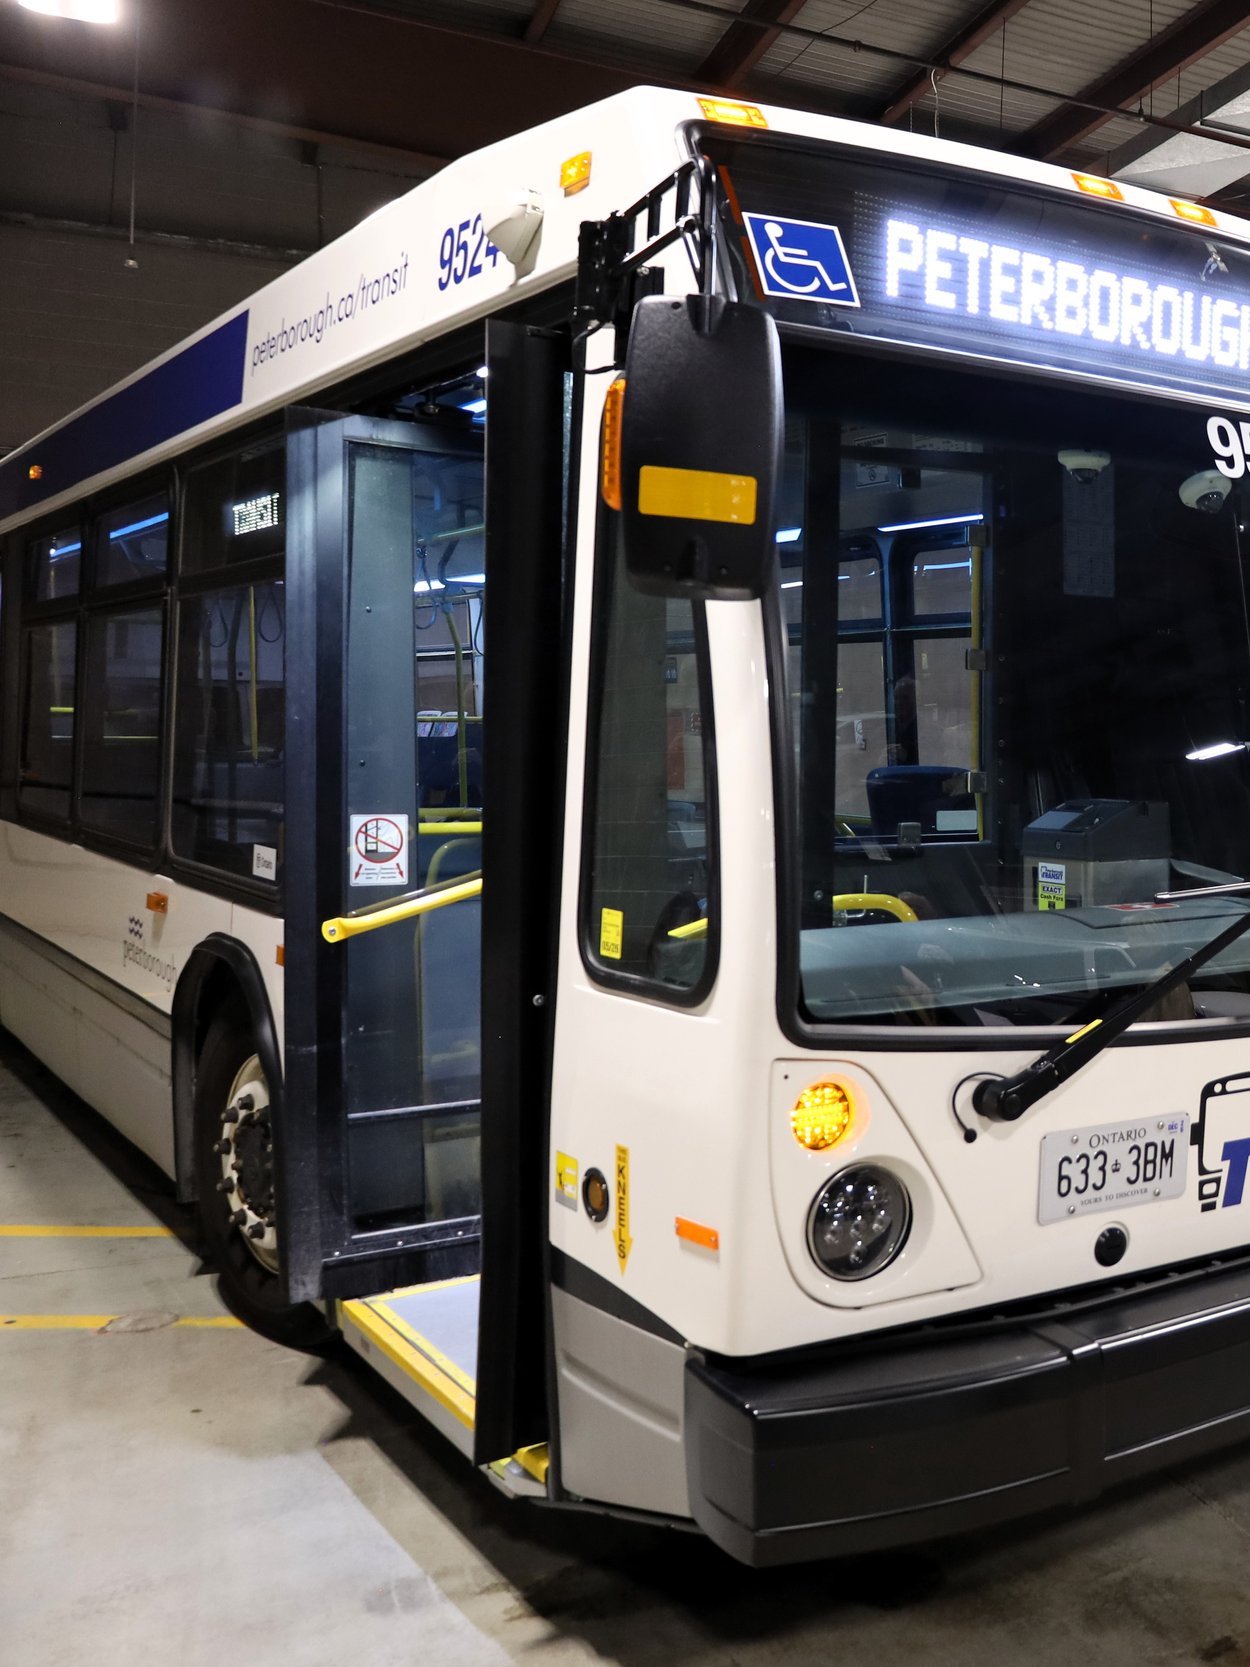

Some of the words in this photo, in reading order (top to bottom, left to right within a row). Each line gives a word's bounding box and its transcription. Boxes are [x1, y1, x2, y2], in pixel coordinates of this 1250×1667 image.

[251, 250, 409, 377] peterborough.ca/transit
[1042, 885, 1061, 894] EXACT
[123, 939, 178, 993] peterborough
[1088, 1127, 1148, 1149] ONTARIO
[1057, 1149, 1108, 1198] 633
[1126, 1138, 1175, 1185] 3BM
[617, 1163, 626, 1259] KNEELS
[1080, 1197, 1103, 1206] YOURS
[1116, 1187, 1149, 1200] DISCOVER
